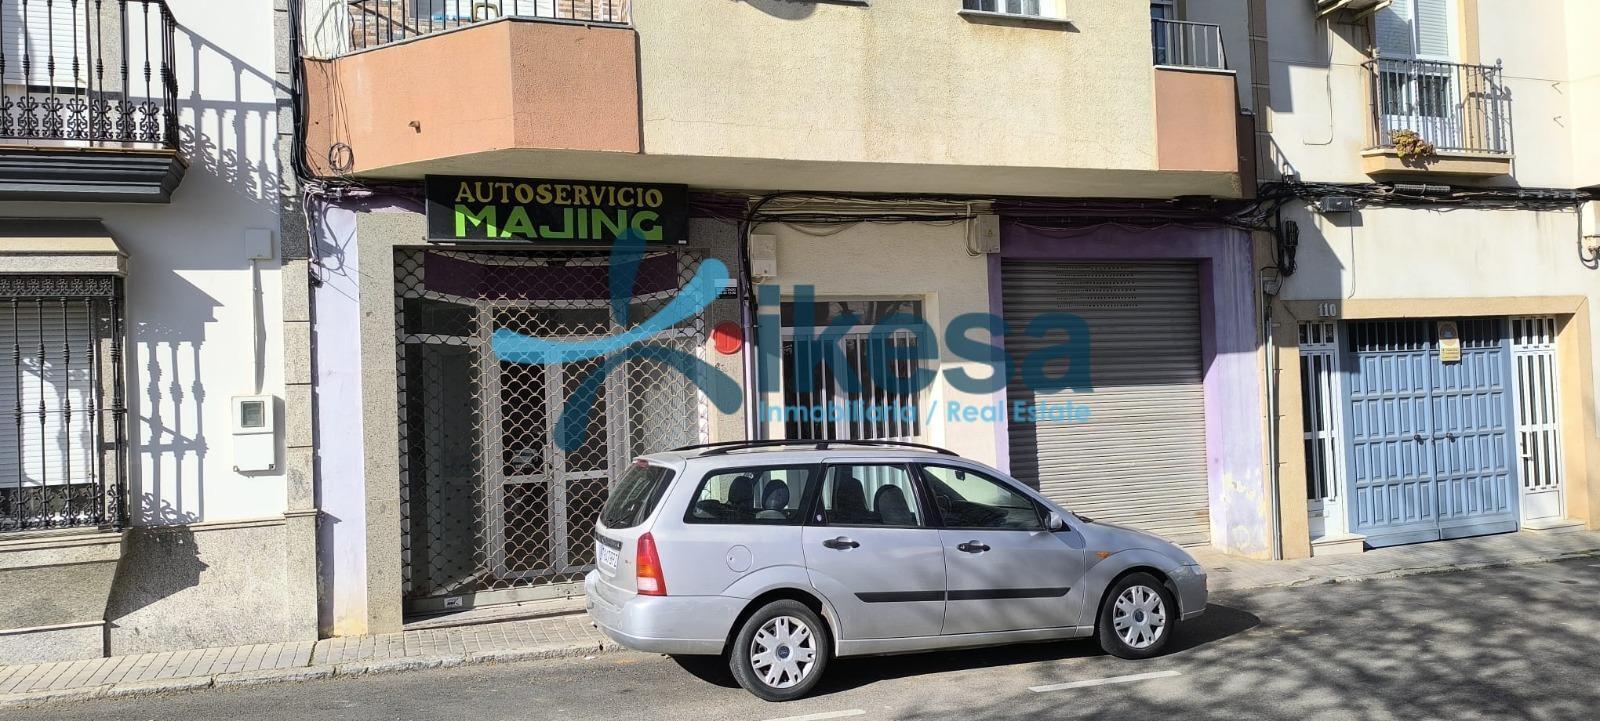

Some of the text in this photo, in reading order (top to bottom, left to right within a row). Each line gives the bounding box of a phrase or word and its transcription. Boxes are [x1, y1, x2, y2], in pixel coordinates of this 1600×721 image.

[455, 181, 663, 208] AUTOSERVICIO
[455, 204, 663, 241] MAJING
[1318, 303, 1336, 317] 110
